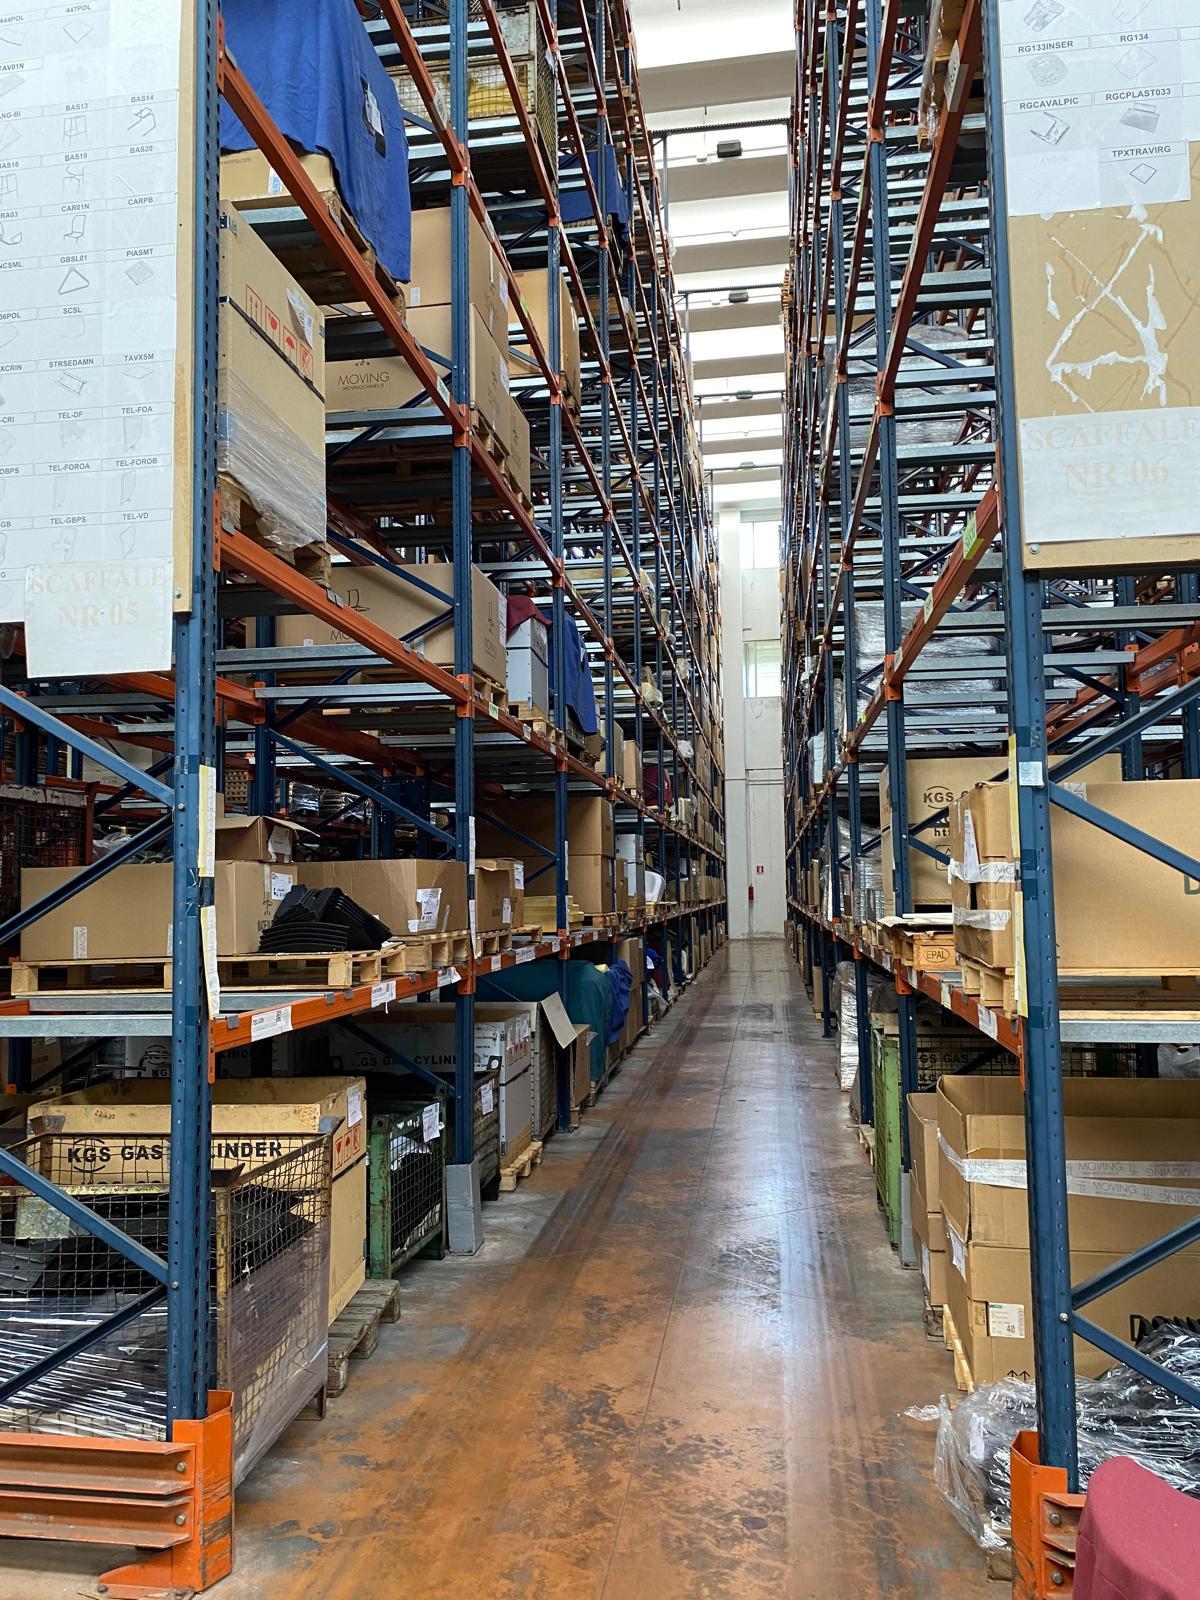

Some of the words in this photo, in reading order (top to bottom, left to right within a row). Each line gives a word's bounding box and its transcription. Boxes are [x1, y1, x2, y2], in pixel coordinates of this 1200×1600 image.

[1120, 33, 1149, 43] RG134
[131, 94, 154, 103] BAS14
[1105, 87, 1171, 101] RGCPLAST033
[65, 103, 89, 112] BAS13
[65, 152, 88, 162] BAS19
[1112, 145, 1172, 158] TPXTRAVIRG
[338, 371, 390, 386] MOVING
[31, 566, 167, 595] SCAFFALE
[110, 602, 140, 627] 05
[923, 791, 954, 804] KGS
[926, 950, 946, 960] EPAL
[67, 1144, 112, 1163] KGS
[120, 1144, 164, 1161] GAS
[1078, 1161, 1122, 1171] MOVING
[1091, 1181, 1137, 1194] MOVING
